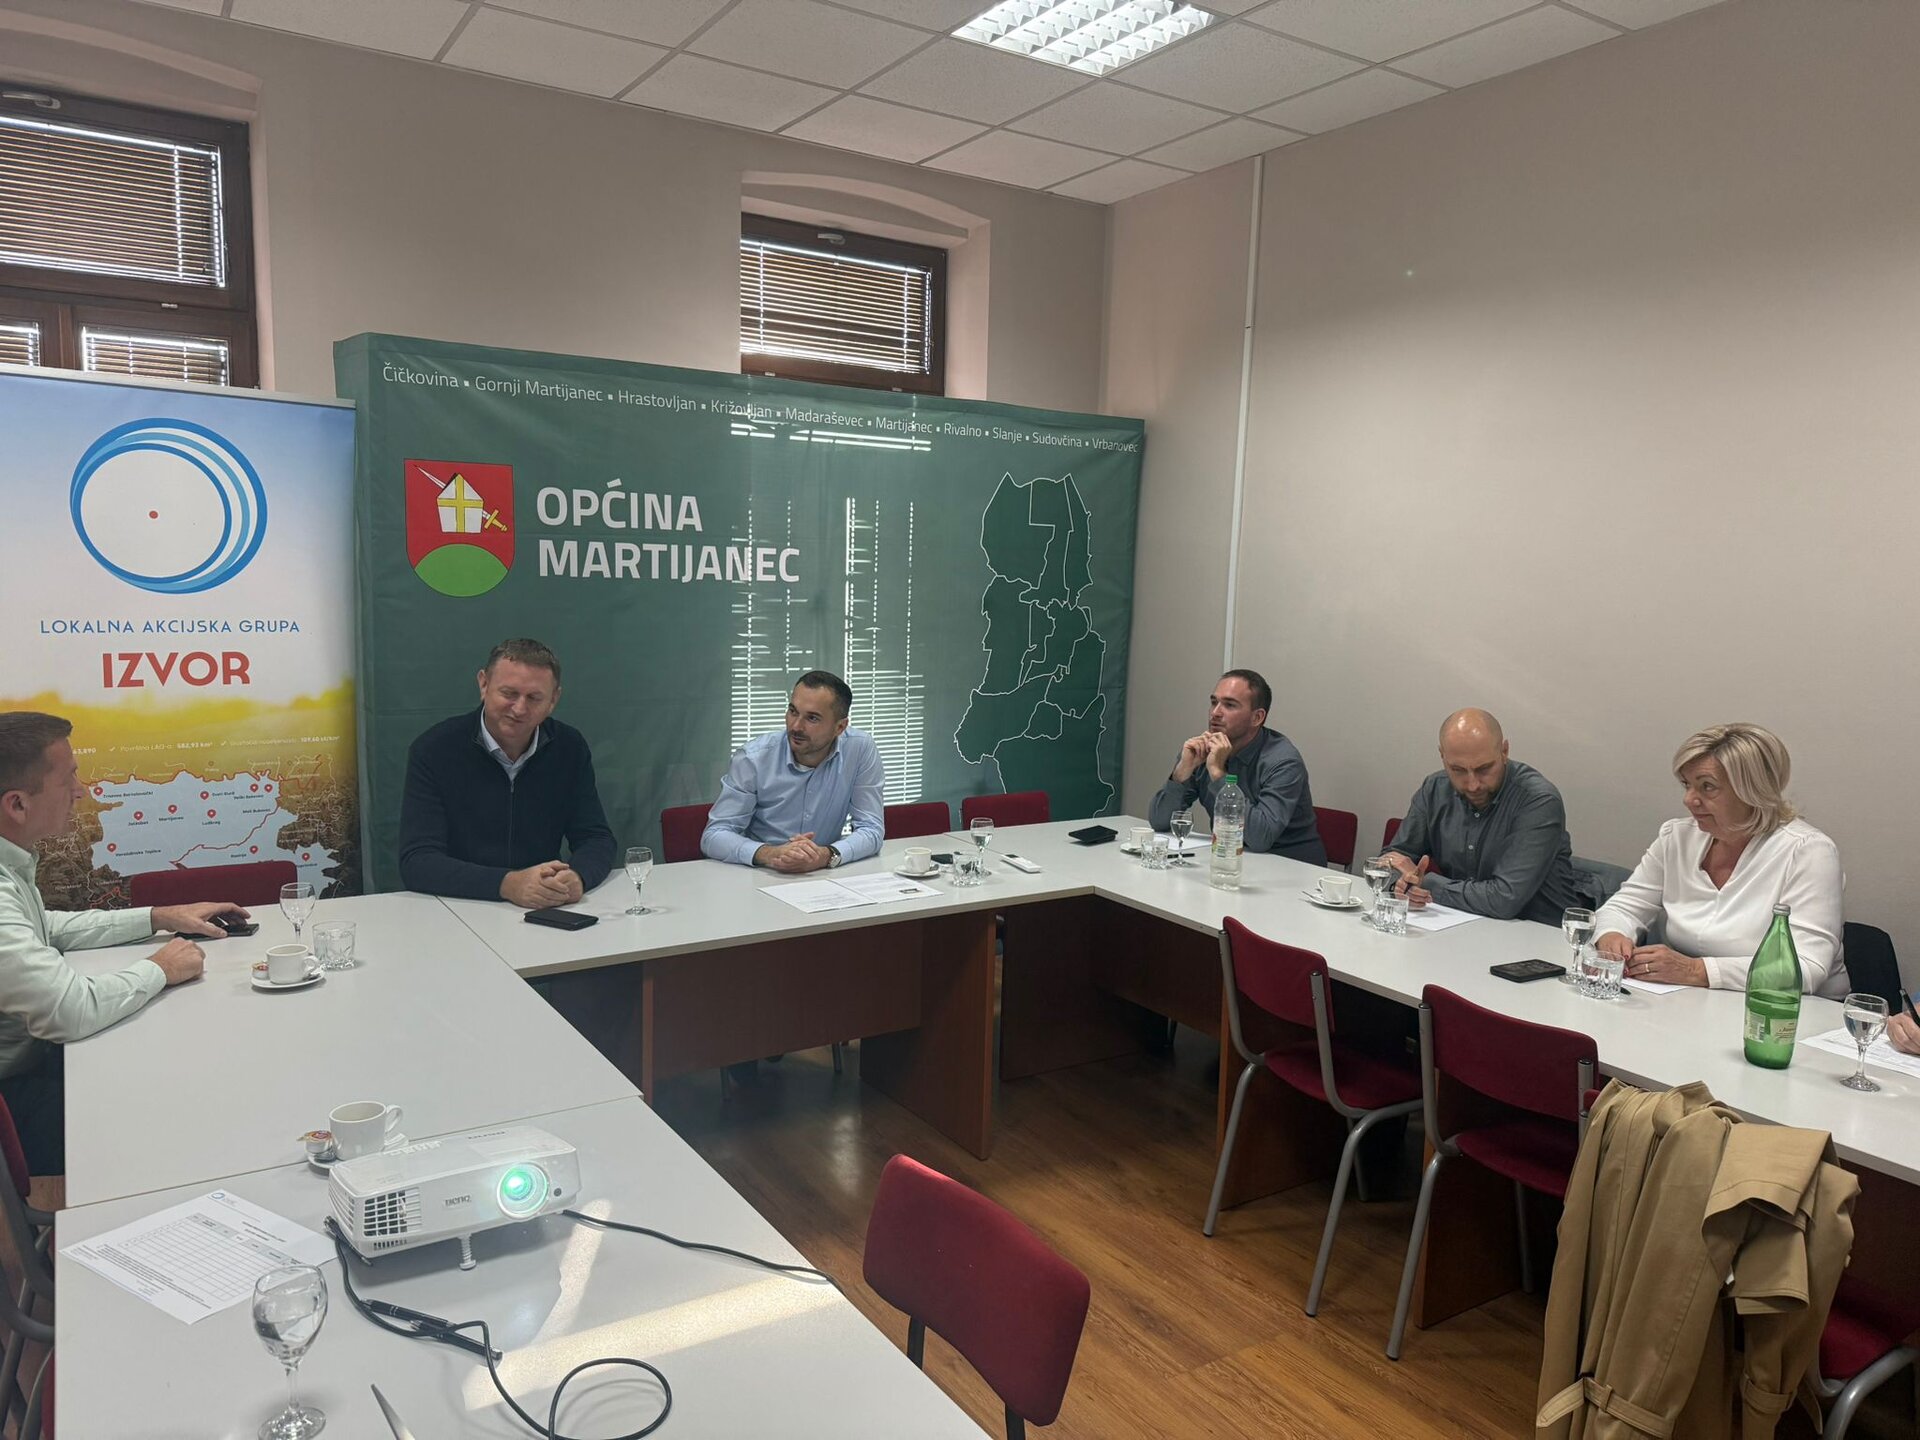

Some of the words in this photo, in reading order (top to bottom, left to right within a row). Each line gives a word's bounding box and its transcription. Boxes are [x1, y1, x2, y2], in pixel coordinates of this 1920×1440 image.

[383, 361, 459, 388] Čičkovina
[475, 375, 522, 395] Gornji
[525, 380, 604, 402] Martijanec
[618, 389, 697, 411] Hrastovljan
[711, 399, 773, 419] Križovljan
[785, 406, 864, 428] Madaraševec
[875, 416, 933, 435] Martijanec
[944, 422, 982, 438] Rivalno
[992, 427, 1023, 443] Slanje
[1032, 430, 1082, 448] Sudovčina
[1092, 437, 1138, 454] Vrbanovec
[536, 477, 703, 533] OPĆINA
[539, 538, 801, 584] MARTIJANEC
[40, 619, 134, 635] LOKALNA
[142, 619, 233, 634] AKCIJSKA
[239, 619, 300, 633] GRUPA
[102, 652, 251, 688] IZVOR
